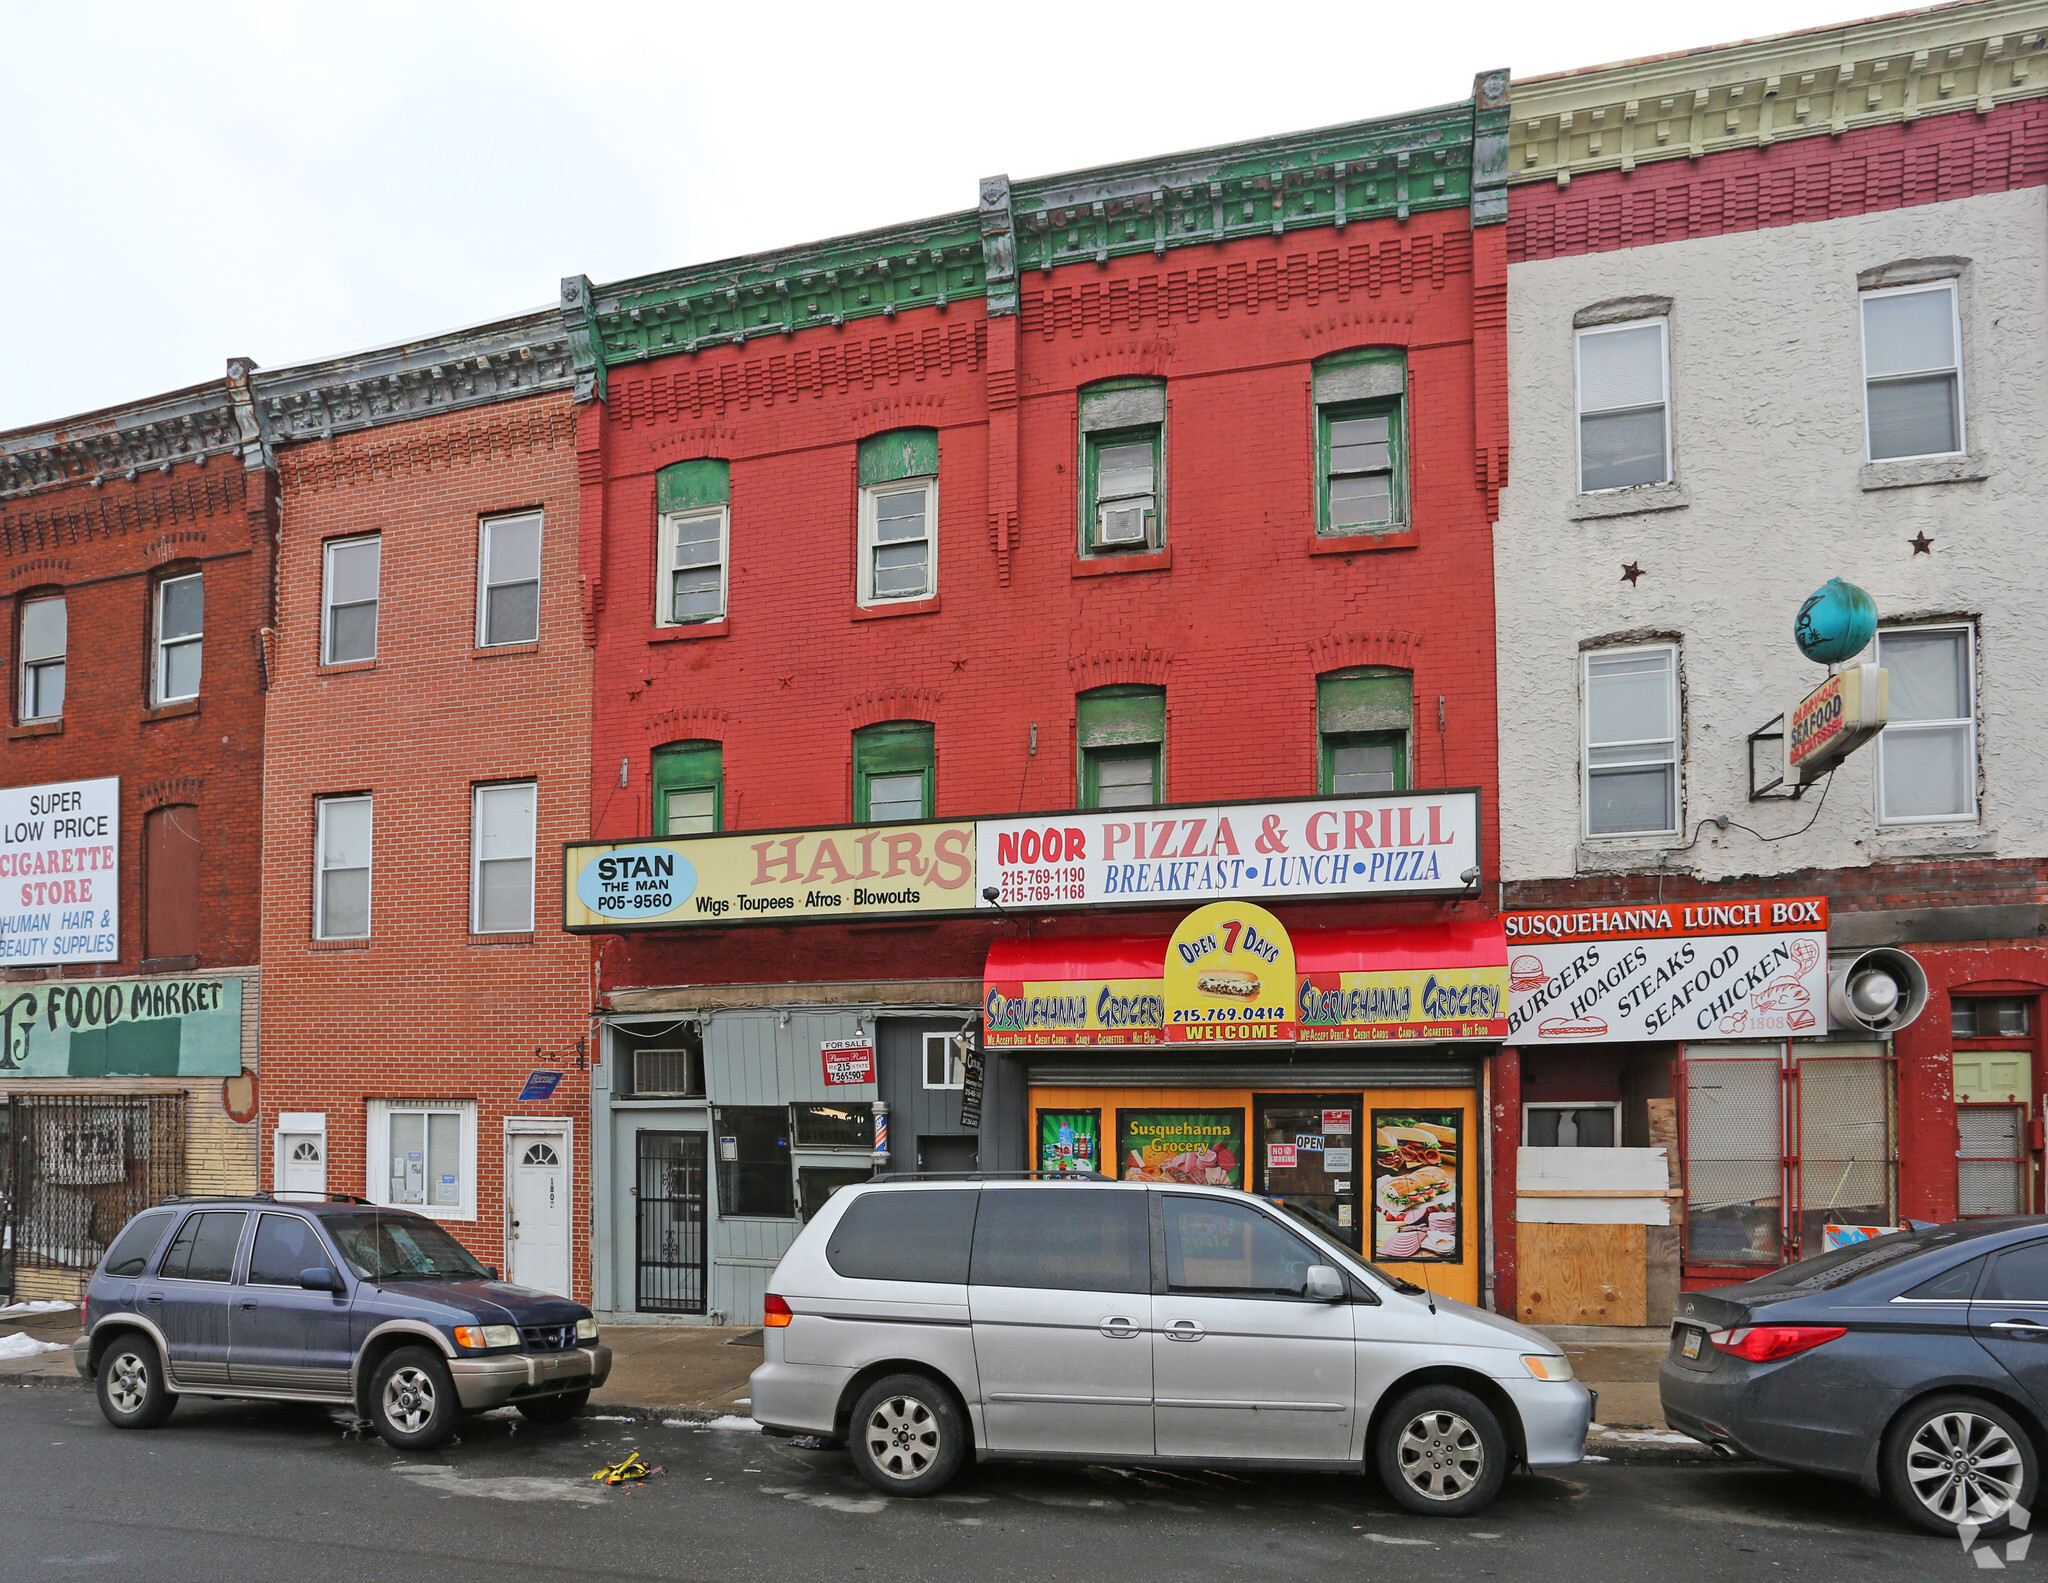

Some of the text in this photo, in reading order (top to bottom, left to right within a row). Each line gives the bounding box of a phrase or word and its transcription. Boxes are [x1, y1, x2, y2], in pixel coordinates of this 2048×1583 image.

[1793, 677, 1841, 725] CARRY-OUT
[1791, 694, 1842, 748] SEAFOOD
[1790, 715, 1843, 764] DELICATESSEN
[30, 791, 82, 815] SUPER
[5, 816, 108, 843] LOW PRICE
[997, 805, 1455, 866] NOOR PIZZA & GRILL
[0, 845, 114, 877] CIGARETTE
[598, 855, 674, 880] STAN
[750, 829, 973, 890] HAIRS
[1103, 850, 1441, 894] BREAKFAST LUNCH PIZZA
[602, 879, 669, 892] THE MAN
[1001, 867, 1085, 886] 215-769-1190
[21, 878, 93, 907] STORE
[695, 887, 920, 915] Wigs Toupees Afros Blowouts
[1001, 884, 1086, 903] 215-769-1168
[1, 909, 111, 933] HUMAN HAIR &
[1504, 901, 1822, 936] SUSQUEHANNA LUNCH BOX
[0, 933, 115, 958] BEAUTY SUPPLIES
[1222, 919, 1243, 955] 7
[1508, 945, 1600, 1035] BURGERS
[1570, 946, 1647, 1020] HOAGIES
[1618, 942, 1696, 1018] STEAKS
[1644, 945, 1740, 1035] SEAFOOD
[1696, 941, 1790, 1031] CHICKEN
[47, 984, 124, 1033] FOOD
[131, 982, 223, 1020] MARKET
[1172, 1007, 1285, 1023] 215.769.0414
[1185, 1024, 1279, 1040] WELCOME
[1750, 1017, 1784, 1030] 1808
[845, 1040, 867, 1048] SALE
[837, 1063, 851, 1071] 215
[1129, 1121, 1231, 1140] Susquehanna
[1297, 1136, 1323, 1150] OPEN
[1150, 1137, 1210, 1157] Grocery
[1270, 1155, 1295, 1163] SMOKING
[1272, 1147, 1283, 1155] NO
